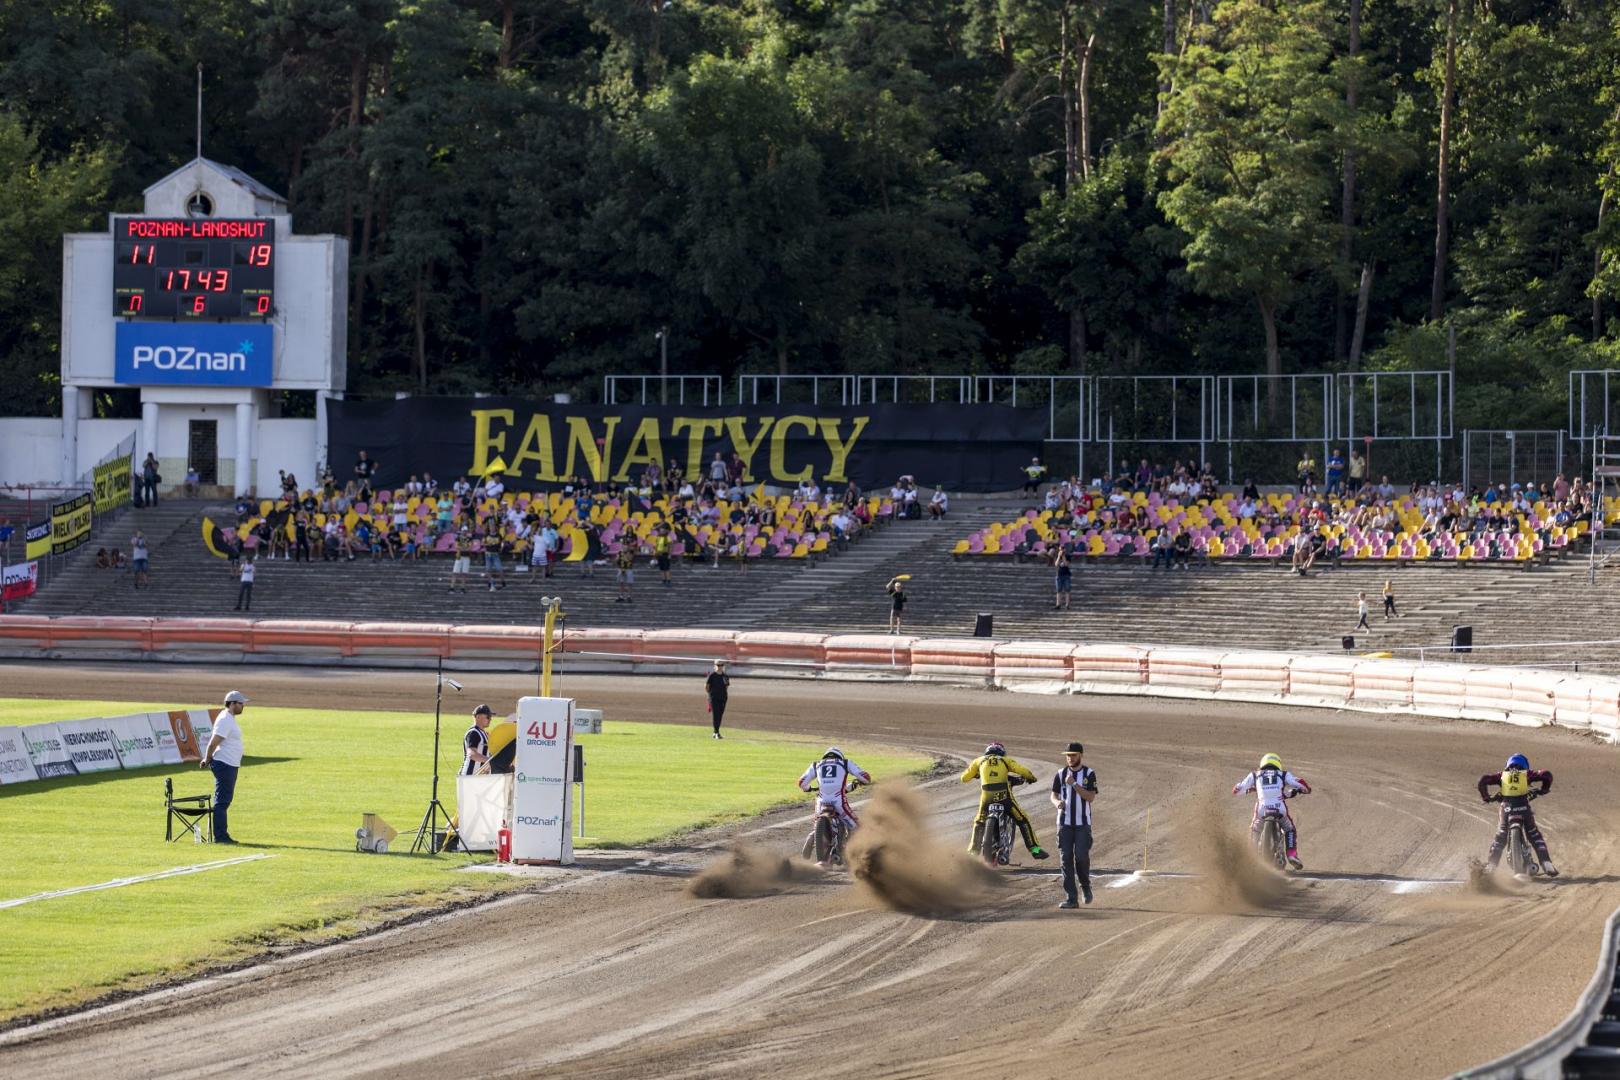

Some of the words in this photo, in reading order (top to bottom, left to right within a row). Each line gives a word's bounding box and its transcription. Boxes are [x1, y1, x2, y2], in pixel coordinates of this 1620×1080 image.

[128, 221, 267, 238] POZNAN-LANDSHUT
[132, 244, 155, 264] 11
[249, 244, 272, 266] 19
[194, 296, 206, 312] 6
[258, 296, 270, 312] 0
[133, 345, 246, 372] POZnan
[467, 408, 870, 484] FANATYCY
[526, 721, 558, 740] 4U
[526, 739, 557, 747] BROKER
[825, 765, 833, 777] 2
[1508, 774, 1520, 783] 15
[517, 815, 556, 826] POZnan
